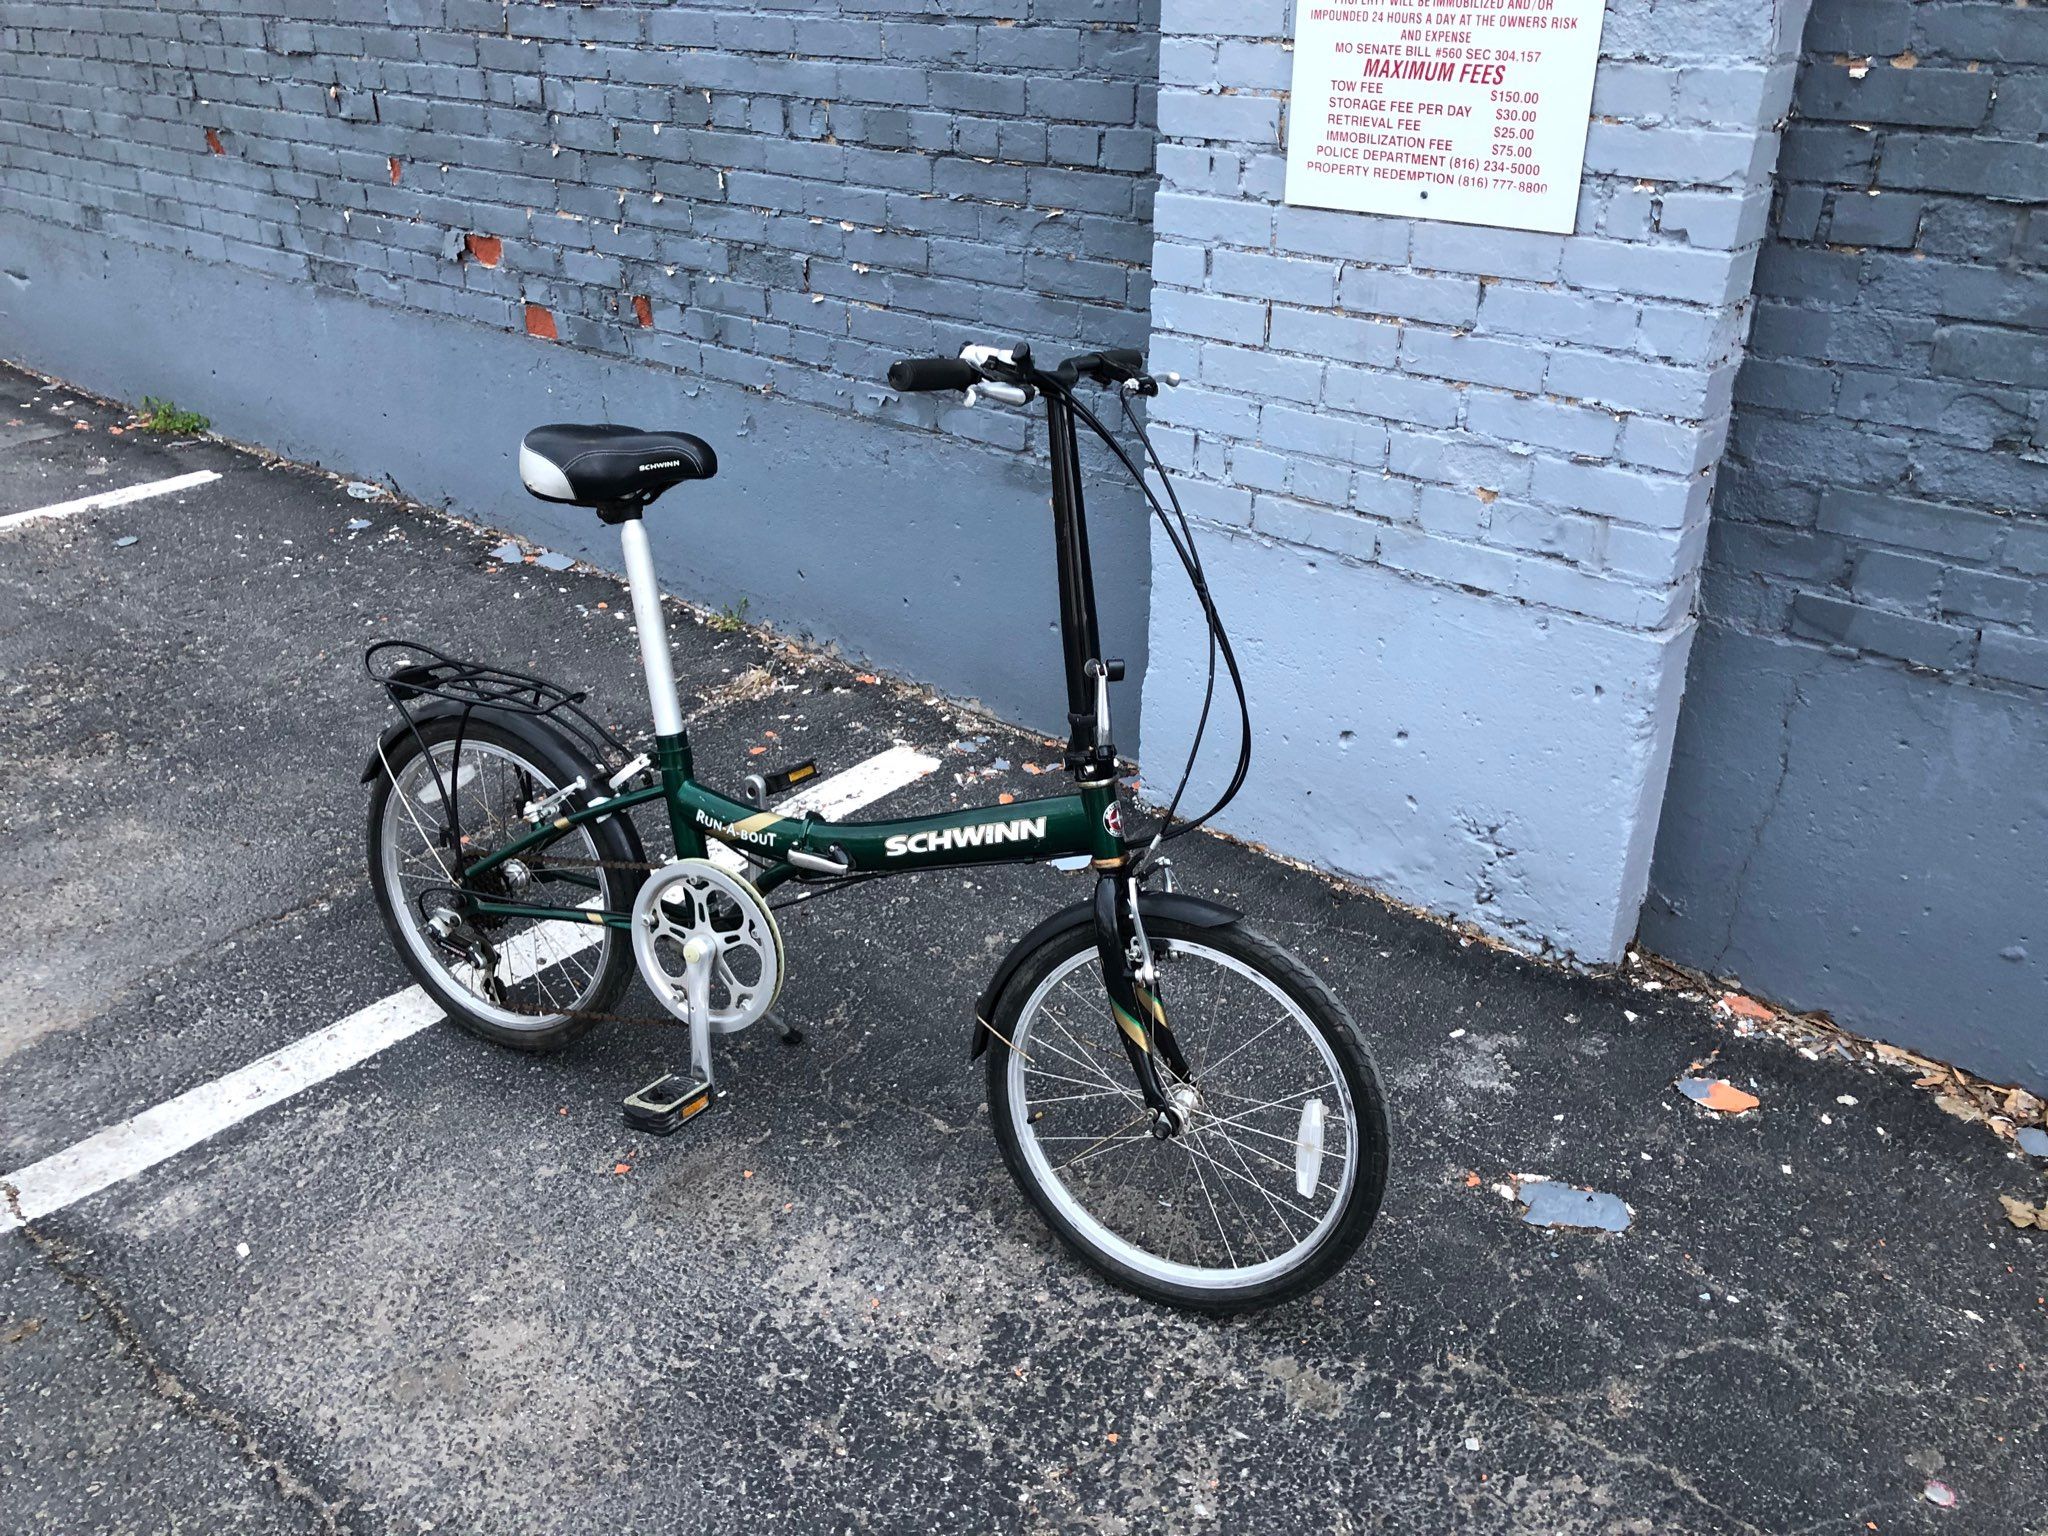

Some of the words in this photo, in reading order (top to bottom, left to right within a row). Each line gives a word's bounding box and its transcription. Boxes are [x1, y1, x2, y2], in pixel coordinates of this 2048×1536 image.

[1507, 0, 1553, 11] AND/OR
[1310, 9, 1368, 22] IMPOUNDED
[1371, 11, 1384, 23] 24
[1387, 11, 1422, 24] HOURS
[1425, 13, 1432, 25] A
[1436, 13, 1456, 26] DAY
[1459, 13, 1472, 26] AT
[1476, 14, 1496, 27] THE
[1500, 15, 1547, 29] OWNERS
[1551, 17, 1578, 30] RISK
[1401, 29, 1421, 41] AND
[1425, 30, 1472, 43] EXPENSE
[1335, 42, 1353, 53] MO
[1356, 43, 1402, 56] SENATE
[1405, 45, 1432, 57] BILL
[1435, 47, 1462, 59] #560
[1465, 48, 1491, 60] SEC
[1495, 49, 1542, 63] 304.157
[1363, 58, 1455, 82] MAXIMUM
[1459, 63, 1506, 85] FEES
[1331, 79, 1357, 92] TOW
[1360, 81, 1384, 94] FEE
[1490, 90, 1539, 104] $150.00
[1329, 96, 1386, 112] STORAGE
[1390, 101, 1414, 113] FEE
[1418, 103, 1443, 116] PER
[1447, 104, 1472, 118] DAY
[1495, 108, 1537, 122] $30.00
[1327, 113, 1394, 130] RETRIEVAL
[1397, 118, 1422, 131] FEE
[1493, 126, 1535, 140] $25.00
[1326, 130, 1425, 149] IMMOBILIZATION
[1429, 138, 1453, 151] FEE
[1491, 144, 1532, 158] $75.00
[1316, 145, 1359, 160] POLICE
[1363, 149, 1446, 167] DEPARTMENT
[1449, 156, 1480, 172] (816)
[1483, 160, 1540, 176] 234-5000
[1306, 161, 1370, 177] PROPERTY
[1373, 167, 1455, 185] REDEMPTION
[1458, 174, 1489, 190] (816)
[1492, 178, 1548, 194] 777-8800
[639, 459, 680, 472] SCHWINN
[695, 808, 777, 847] RUN-A-BOUT
[884, 816, 1048, 857] SCHWINN
